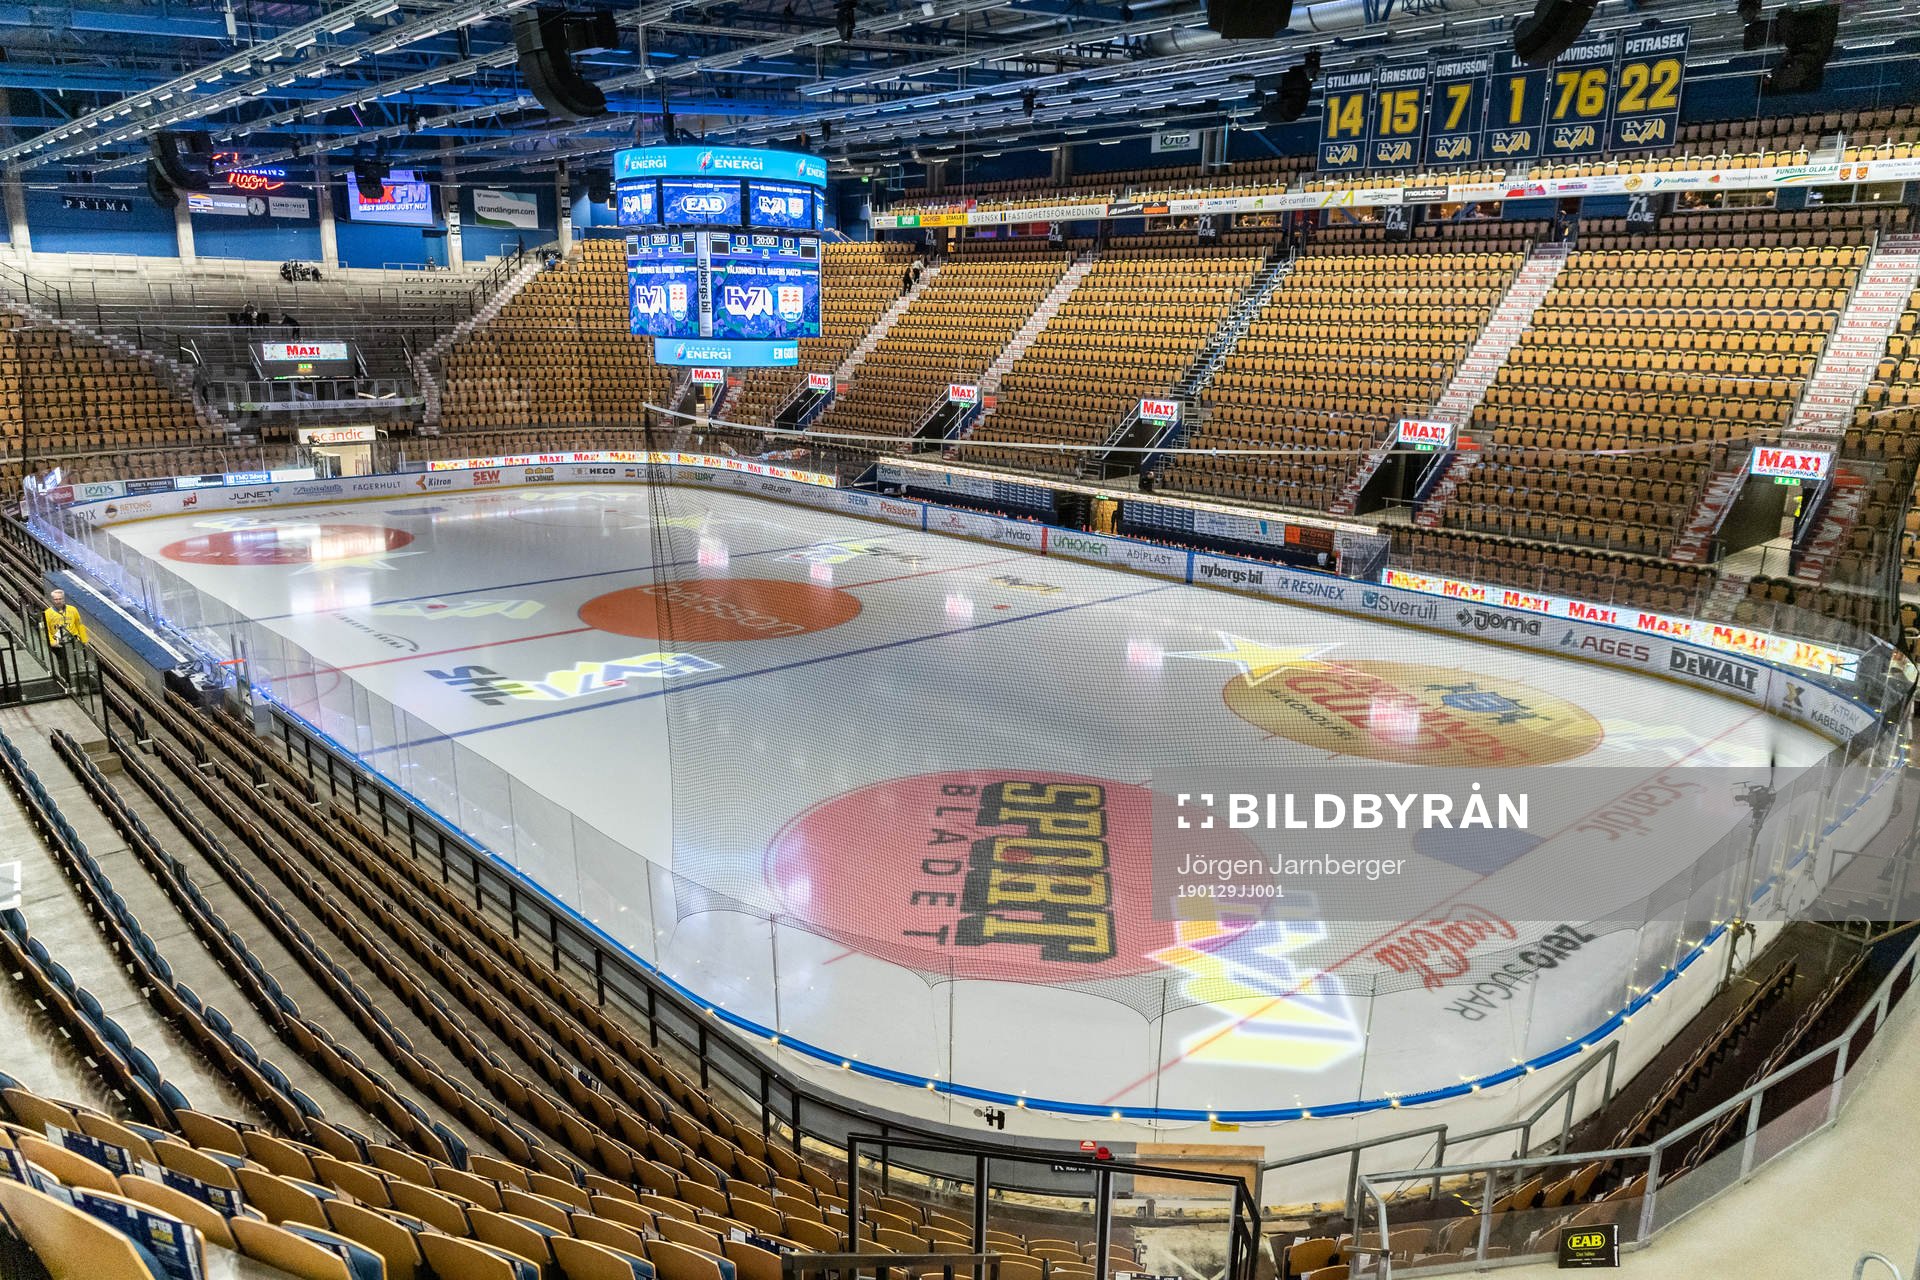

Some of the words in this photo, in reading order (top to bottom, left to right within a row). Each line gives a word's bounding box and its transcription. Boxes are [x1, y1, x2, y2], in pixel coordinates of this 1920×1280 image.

[1625, 33, 1686, 54] PETRASEK
[1380, 67, 1426, 83] ÖRNSKOG
[1436, 60, 1488, 77] GUSTAFSSON
[1327, 72, 1371, 88] STILLMAN
[1617, 58, 1681, 113] 22
[1509, 77, 1527, 124] 1
[1552, 68, 1609, 119] 76
[1379, 89, 1420, 135] 15
[1444, 84, 1472, 130] 7
[1327, 94, 1364, 138] 14
[1776, 166, 1807, 175] FUNDINS
[66, 200, 129, 212] PRIMA
[477, 205, 536, 216] strandängen.com
[685, 198, 724, 211] EAB
[1627, 196, 1649, 213] 71
[972, 214, 998, 223] SVENSK
[1008, 207, 1100, 220] FASTIGHETSFÖRMEDLING
[1626, 212, 1655, 222] ZONE
[756, 237, 775, 245] 20:00
[699, 258, 711, 300] nybergs
[701, 301, 711, 313] bil
[725, 286, 773, 321] HV71
[286, 345, 320, 355] MAXI
[694, 369, 721, 380] MAXI
[810, 375, 829, 386] MAXI
[951, 385, 976, 398] MAXI
[1143, 401, 1174, 417] MAXI
[312, 429, 364, 442] Scandic
[1402, 422, 1446, 440] MAXI
[539, 455, 564, 463] MAXI
[1758, 450, 1821, 471] MAXI
[428, 478, 451, 487] Kitron
[473, 470, 500, 481] SEW
[679, 471, 716, 482] SUBWAY
[353, 481, 401, 491] FAGERHULT
[229, 490, 273, 500] JUNET
[880, 501, 917, 517] Passera
[1006, 527, 1031, 541] Hydro
[1200, 563, 1246, 584] nybergs
[1248, 570, 1263, 585] bil
[1291, 579, 1345, 600] RESINEX
[1504, 591, 1549, 612] MAXI
[1569, 601, 1617, 624] MAXI
[1638, 613, 1692, 637] MAXI
[1581, 636, 1650, 662] AGES
[902, 783, 978, 946] BLADET
[965, 780, 1116, 964] SPORT
[1443, 962, 1534, 1022] SUGAR
[1572, 1234, 1603, 1249] EAB
